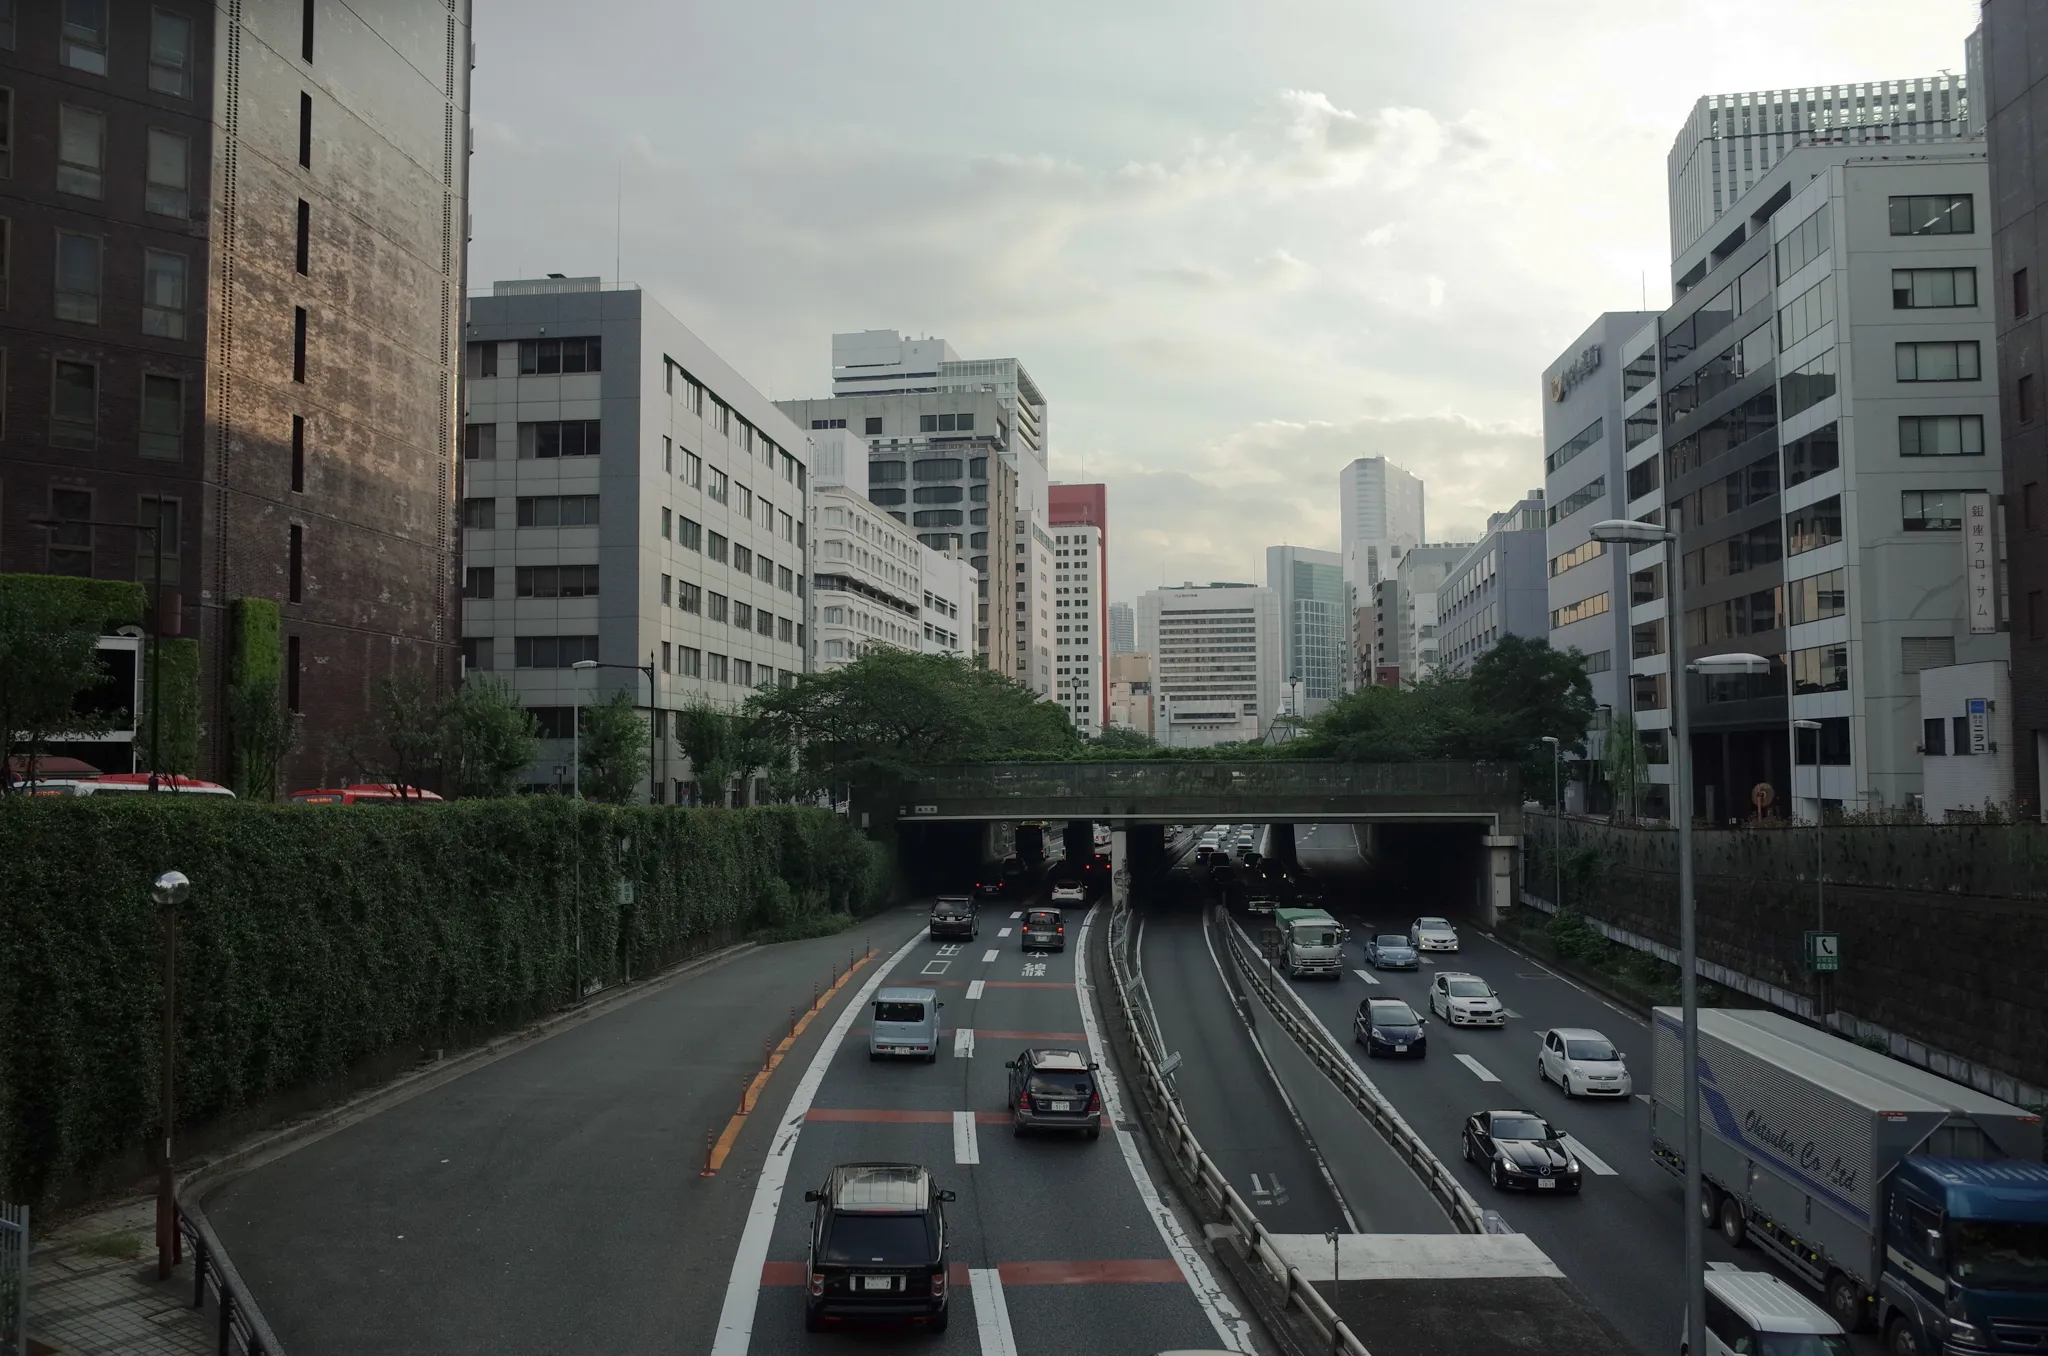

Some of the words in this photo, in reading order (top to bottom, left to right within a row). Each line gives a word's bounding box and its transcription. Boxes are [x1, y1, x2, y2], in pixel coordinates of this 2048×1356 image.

[1972, 505, 1987, 616] 銀座ブロッサム
[1973, 725, 1985, 751] ニラコ
